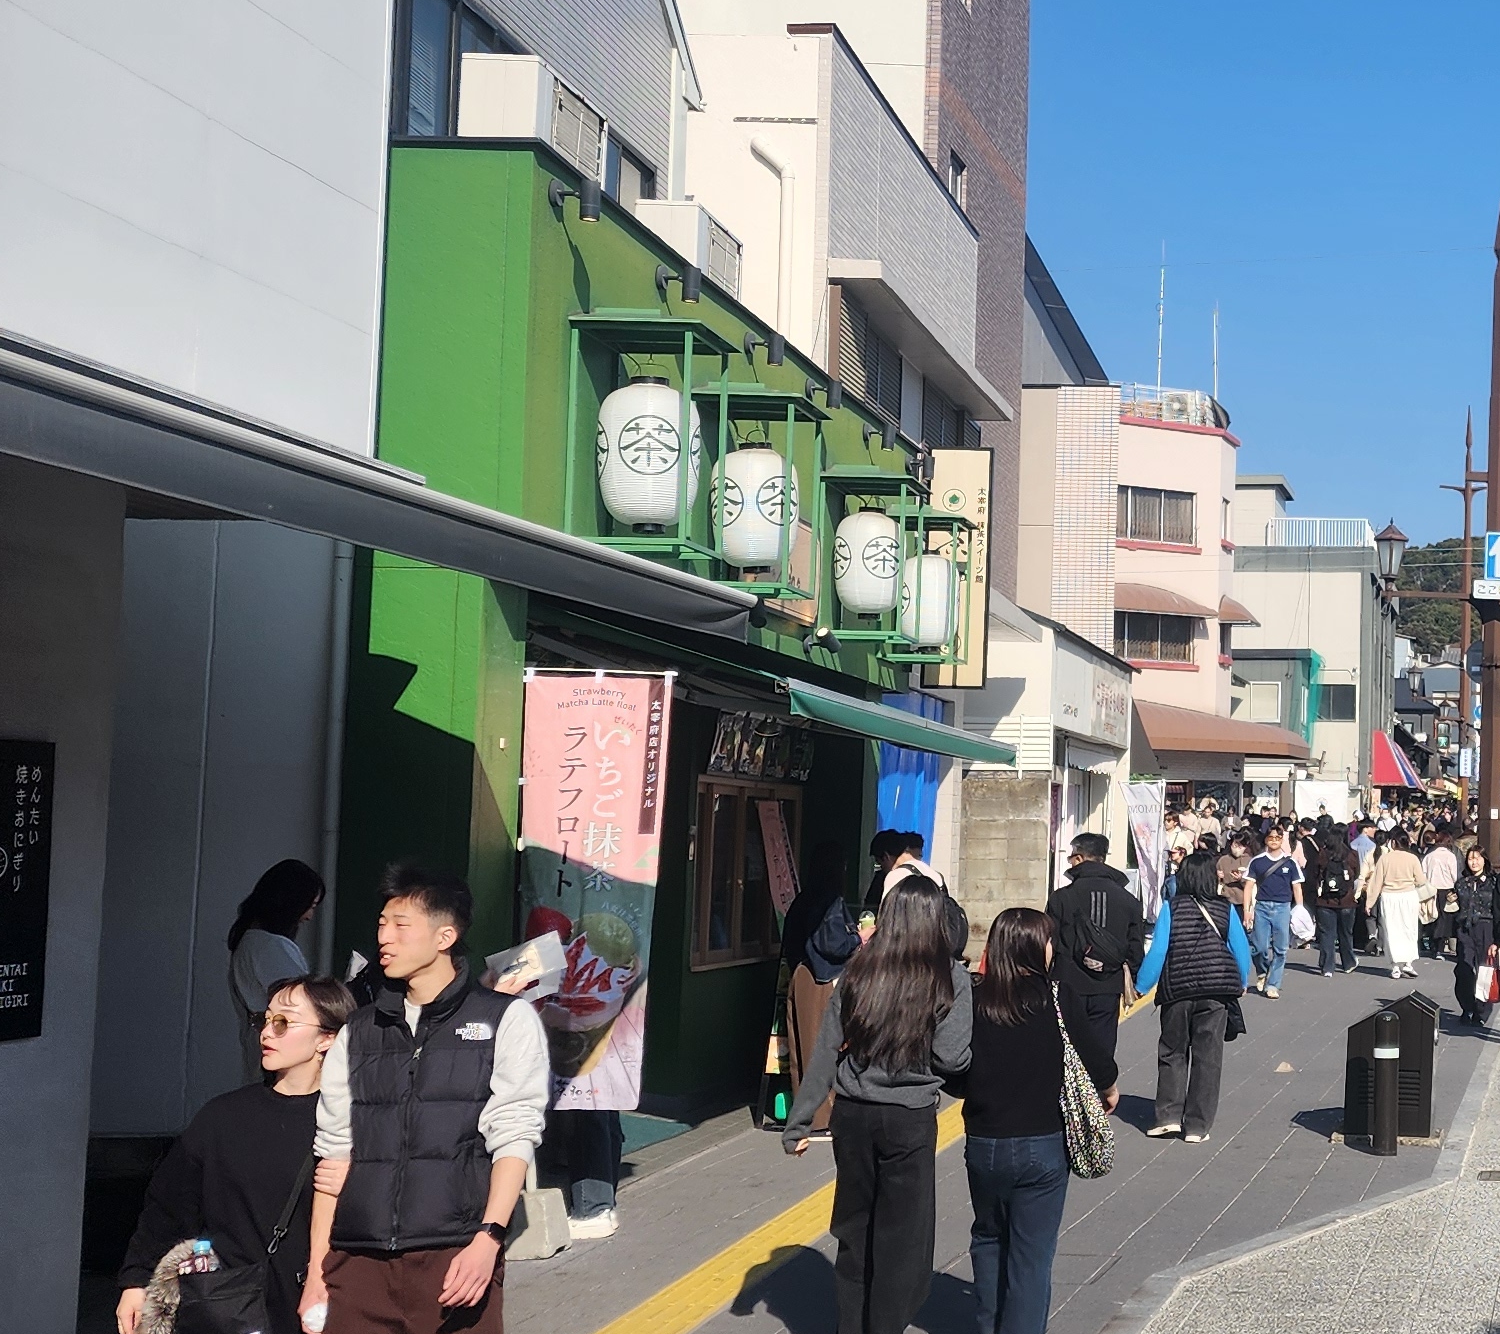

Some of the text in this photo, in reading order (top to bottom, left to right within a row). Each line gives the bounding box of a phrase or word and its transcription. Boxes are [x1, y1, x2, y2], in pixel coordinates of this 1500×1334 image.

[620, 422, 680, 467] 茶
[758, 481, 797, 520] 茶
[863, 539, 900, 573] 茶
[557, 697, 637, 712] Matcha Latte float
[572, 688, 626, 700] Strawberry
[613, 715, 643, 735] ぜいたく
[642, 700, 662, 809] 太宰府店オリジナル
[29, 766, 42, 845] めんたい
[557, 726, 588, 898] ラテフロート
[583, 721, 631, 892] いちご抹茶
[12, 764, 28, 893] 焼きおにぎり
